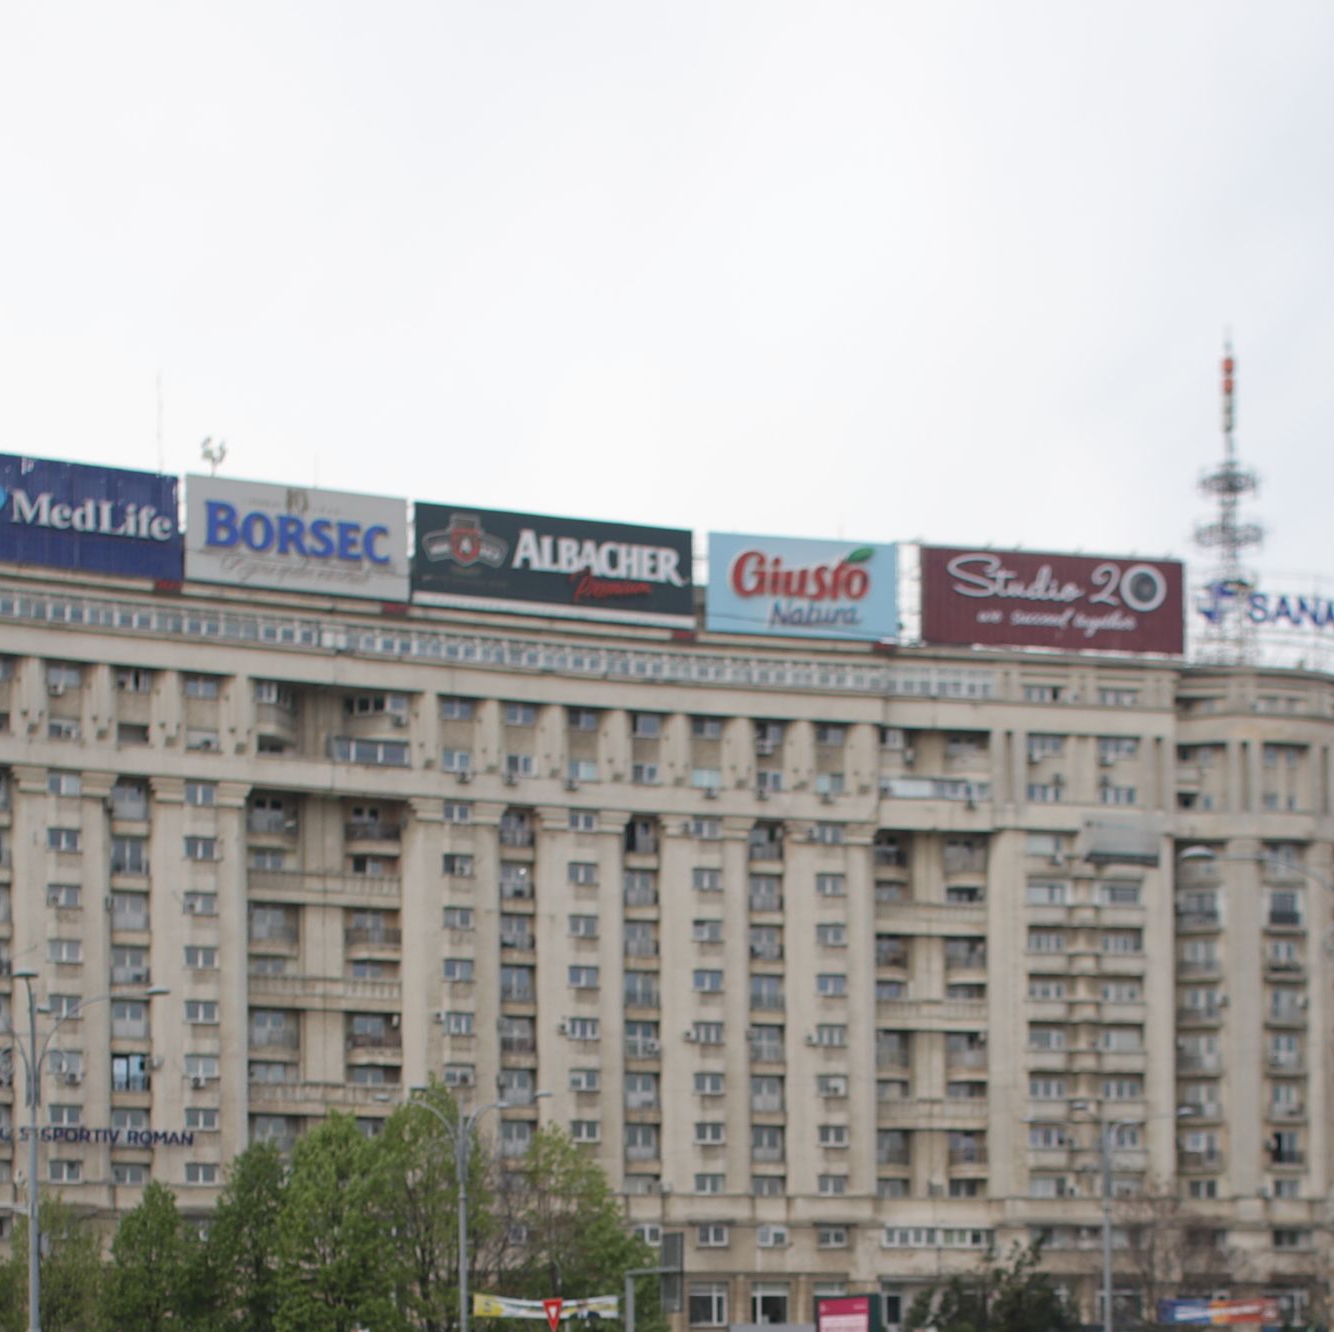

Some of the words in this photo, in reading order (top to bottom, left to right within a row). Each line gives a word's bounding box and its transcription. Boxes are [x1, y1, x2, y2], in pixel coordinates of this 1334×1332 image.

[10, 488, 172, 541] MedLife
[204, 500, 390, 565] BORSEC
[511, 528, 689, 587] ALBACHER
[732, 551, 870, 602] Giusto
[948, 553, 1083, 602] Studio
[1090, 563, 1166, 611] 20
[770, 601, 861, 628] Natura
[41, 1127, 120, 1144] SPORTIV
